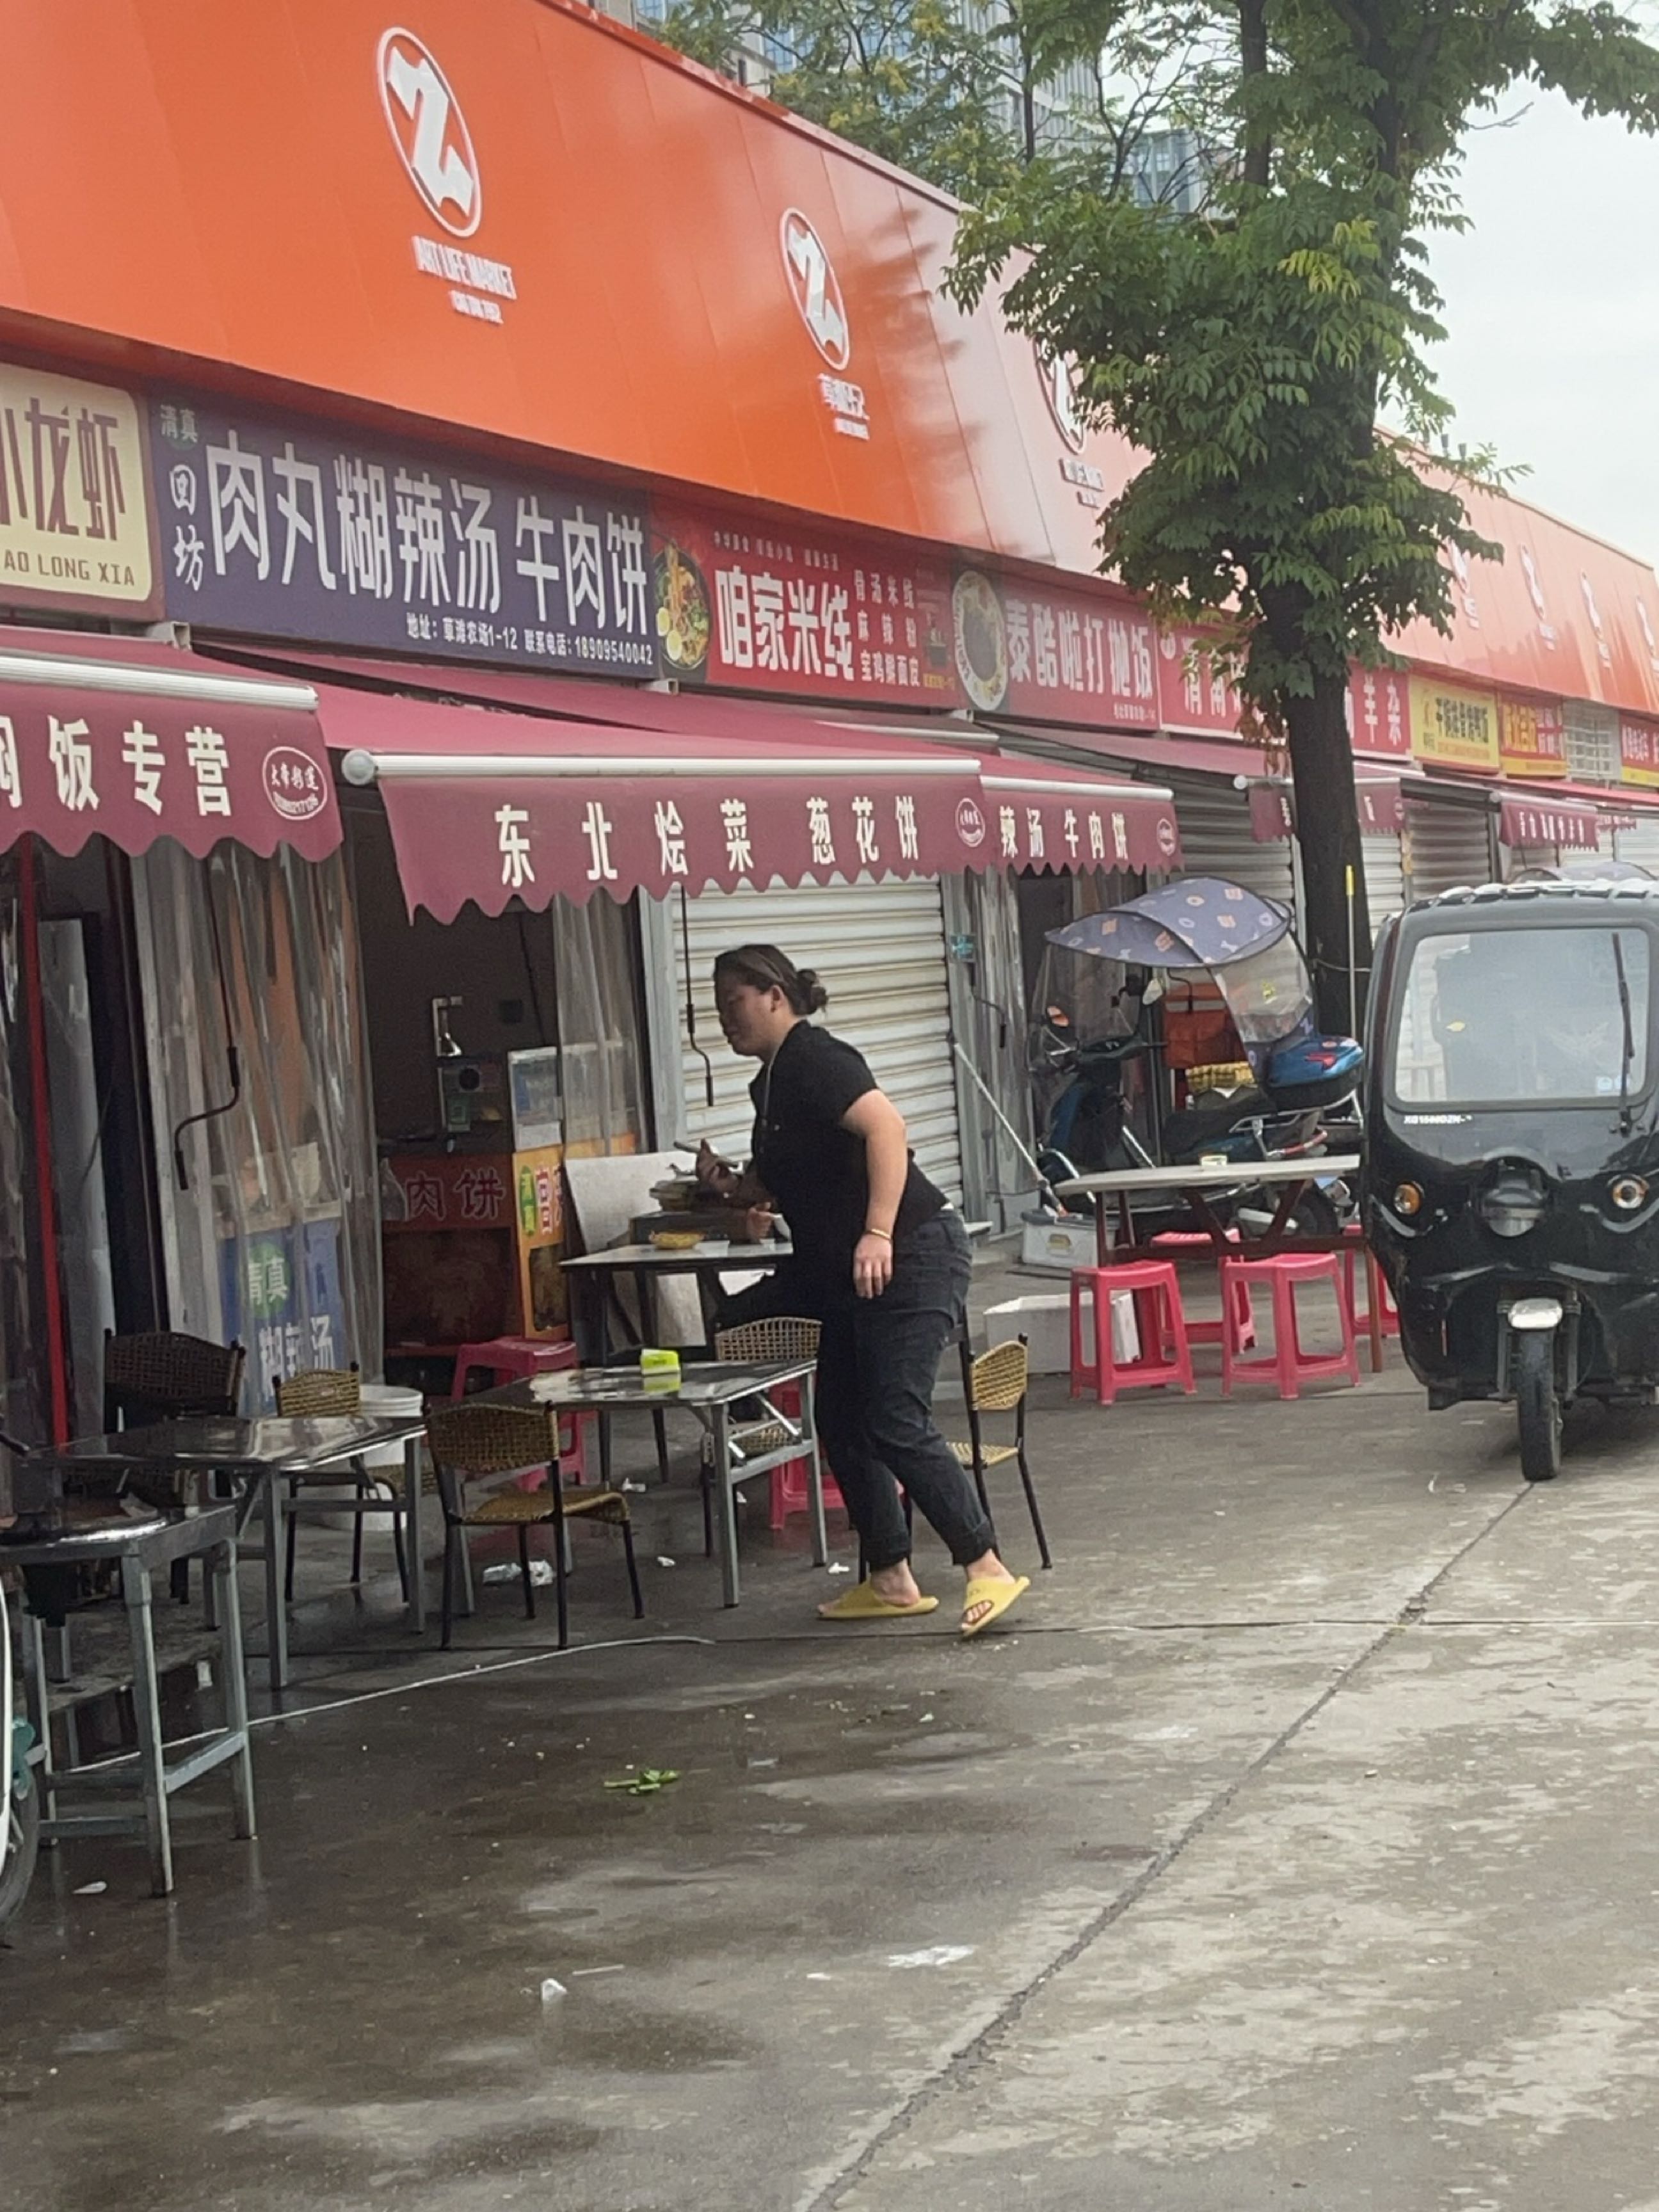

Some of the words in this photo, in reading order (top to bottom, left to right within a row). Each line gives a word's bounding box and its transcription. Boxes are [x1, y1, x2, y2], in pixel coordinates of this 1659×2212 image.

[38, 554, 91, 581] LONG
[97, 561, 135, 586] XIA
[205, 429, 501, 614] 肉丸糊辣汤
[515, 495, 648, 636] 牛肉饼
[714, 565, 854, 682] 咱家米线
[494, 798, 755, 888] 东北烩菜
[806, 796, 919, 865] 葱花饼
[405, 1167, 508, 1221] 肉饼
